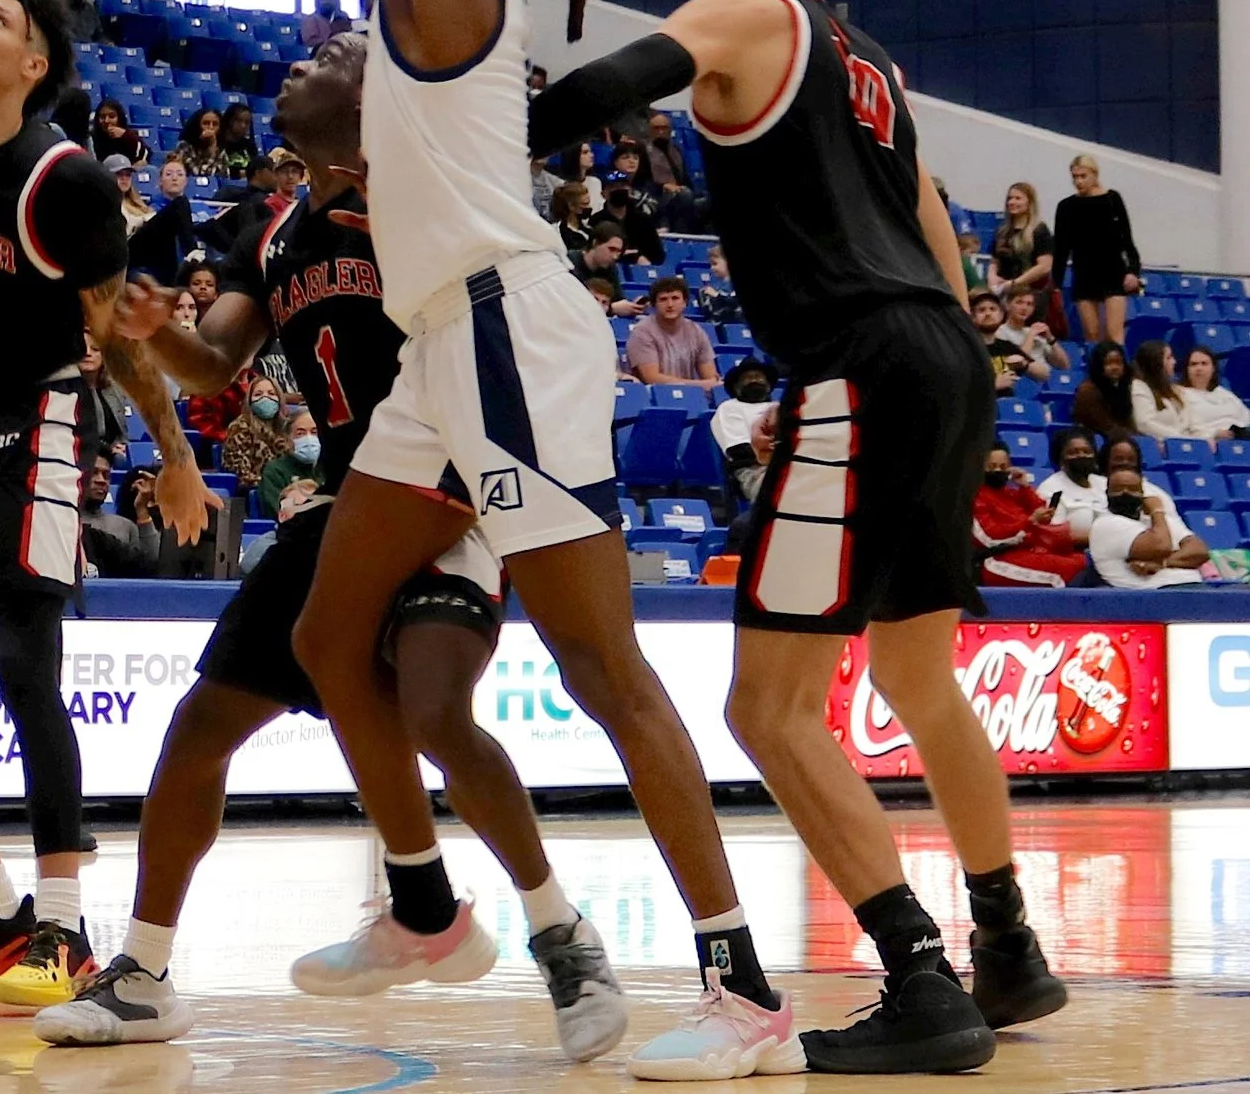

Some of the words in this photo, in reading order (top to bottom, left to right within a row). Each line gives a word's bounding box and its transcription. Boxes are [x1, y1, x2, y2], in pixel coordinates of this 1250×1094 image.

[314, 324, 355, 429] 1
[125, 653, 192, 686] FOR
[851, 639, 1066, 758] C-Cola
[251, 729, 297, 749] doctor
[531, 728, 570, 742] Health
[574, 726, 607, 740] Cente
